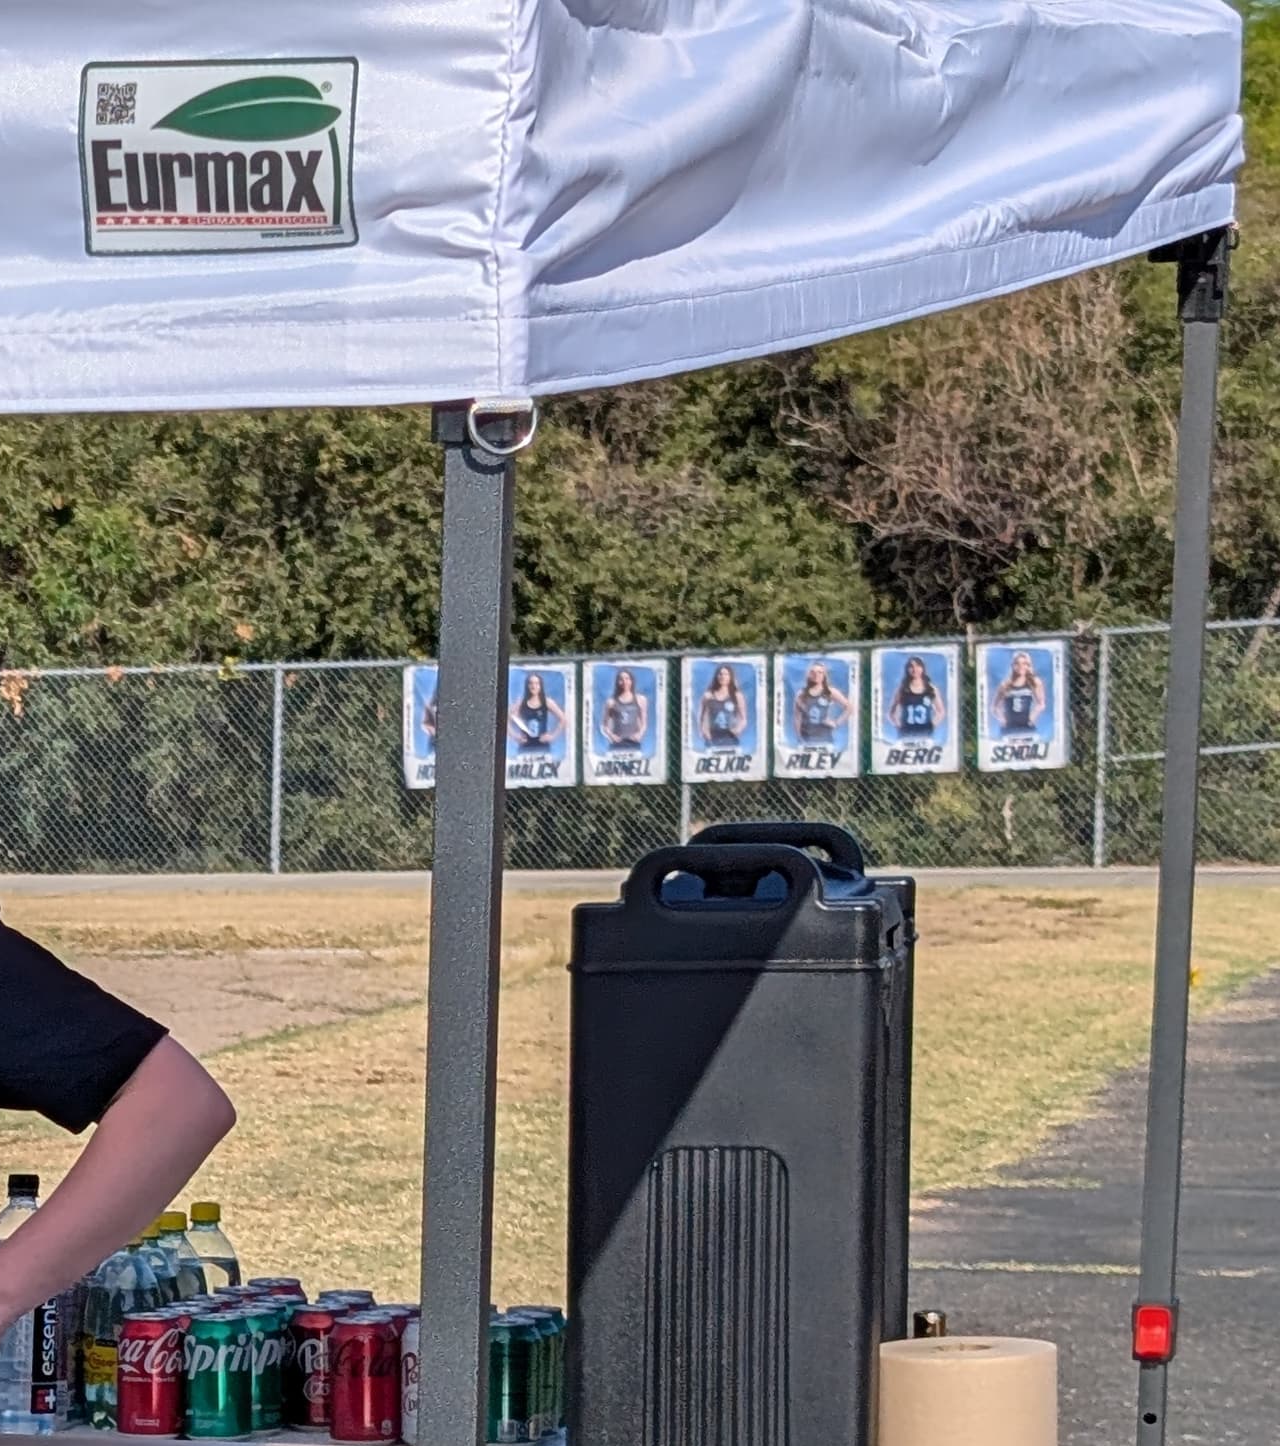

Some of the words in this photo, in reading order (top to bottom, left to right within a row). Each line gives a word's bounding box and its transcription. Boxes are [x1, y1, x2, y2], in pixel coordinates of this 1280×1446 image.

[91, 138, 325, 213] Eurmax
[906, 704, 928, 725] 13
[786, 753, 841, 770] RILEY
[886, 746, 943, 766] BERG
